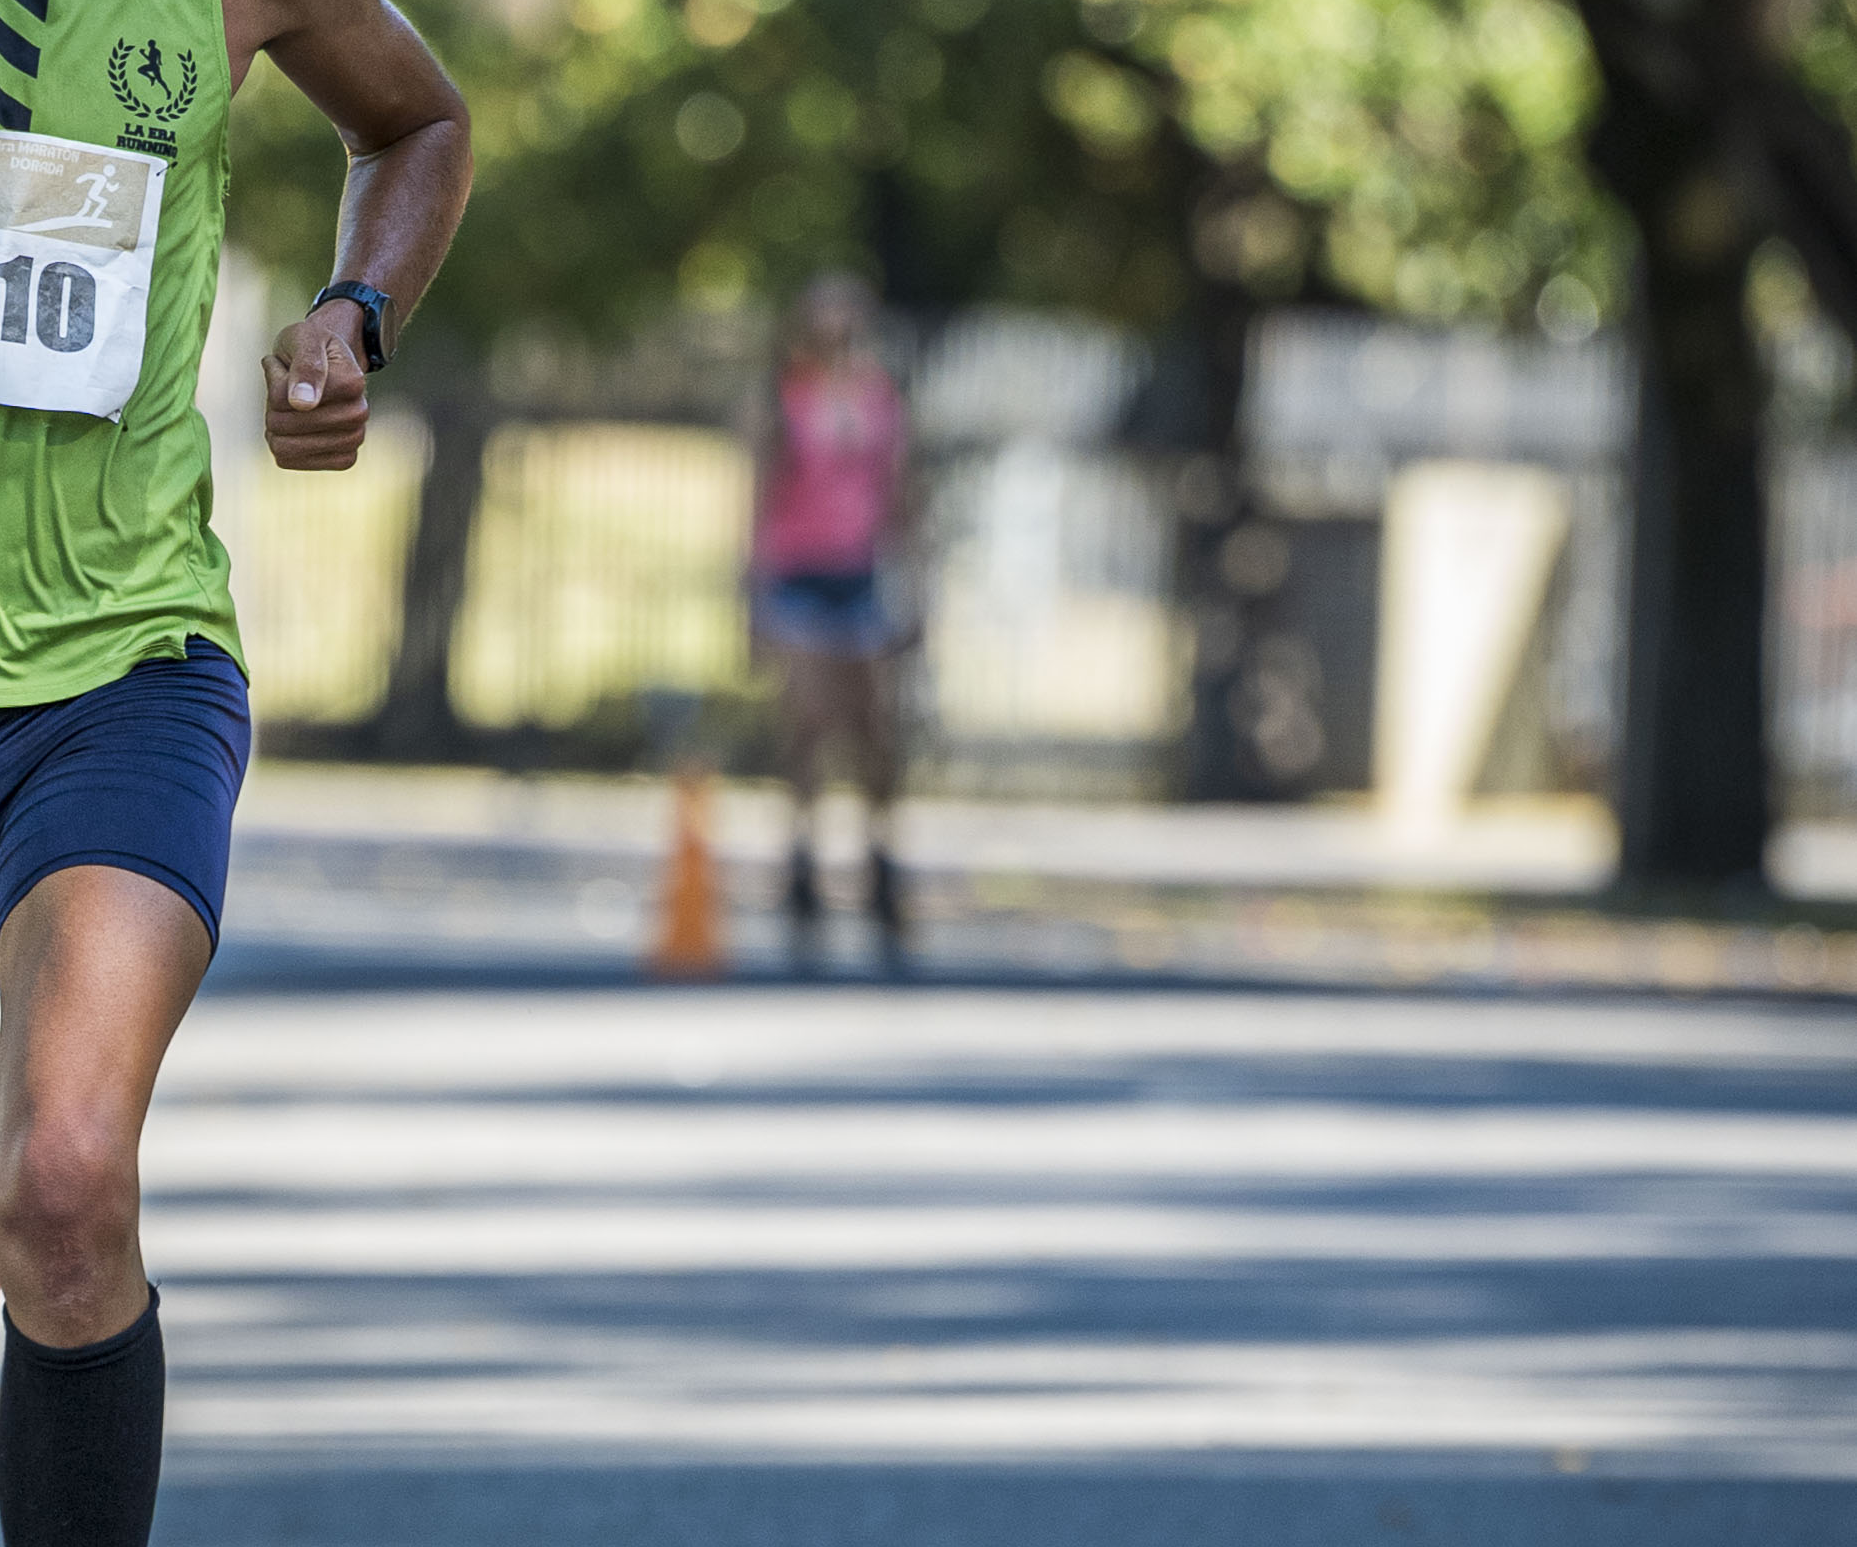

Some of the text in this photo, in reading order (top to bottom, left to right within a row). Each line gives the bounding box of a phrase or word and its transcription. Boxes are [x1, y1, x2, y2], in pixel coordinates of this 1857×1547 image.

[124, 123, 176, 144] LA ERA
[116, 135, 178, 159] RUNNING
[10, 155, 64, 178] DORADA
